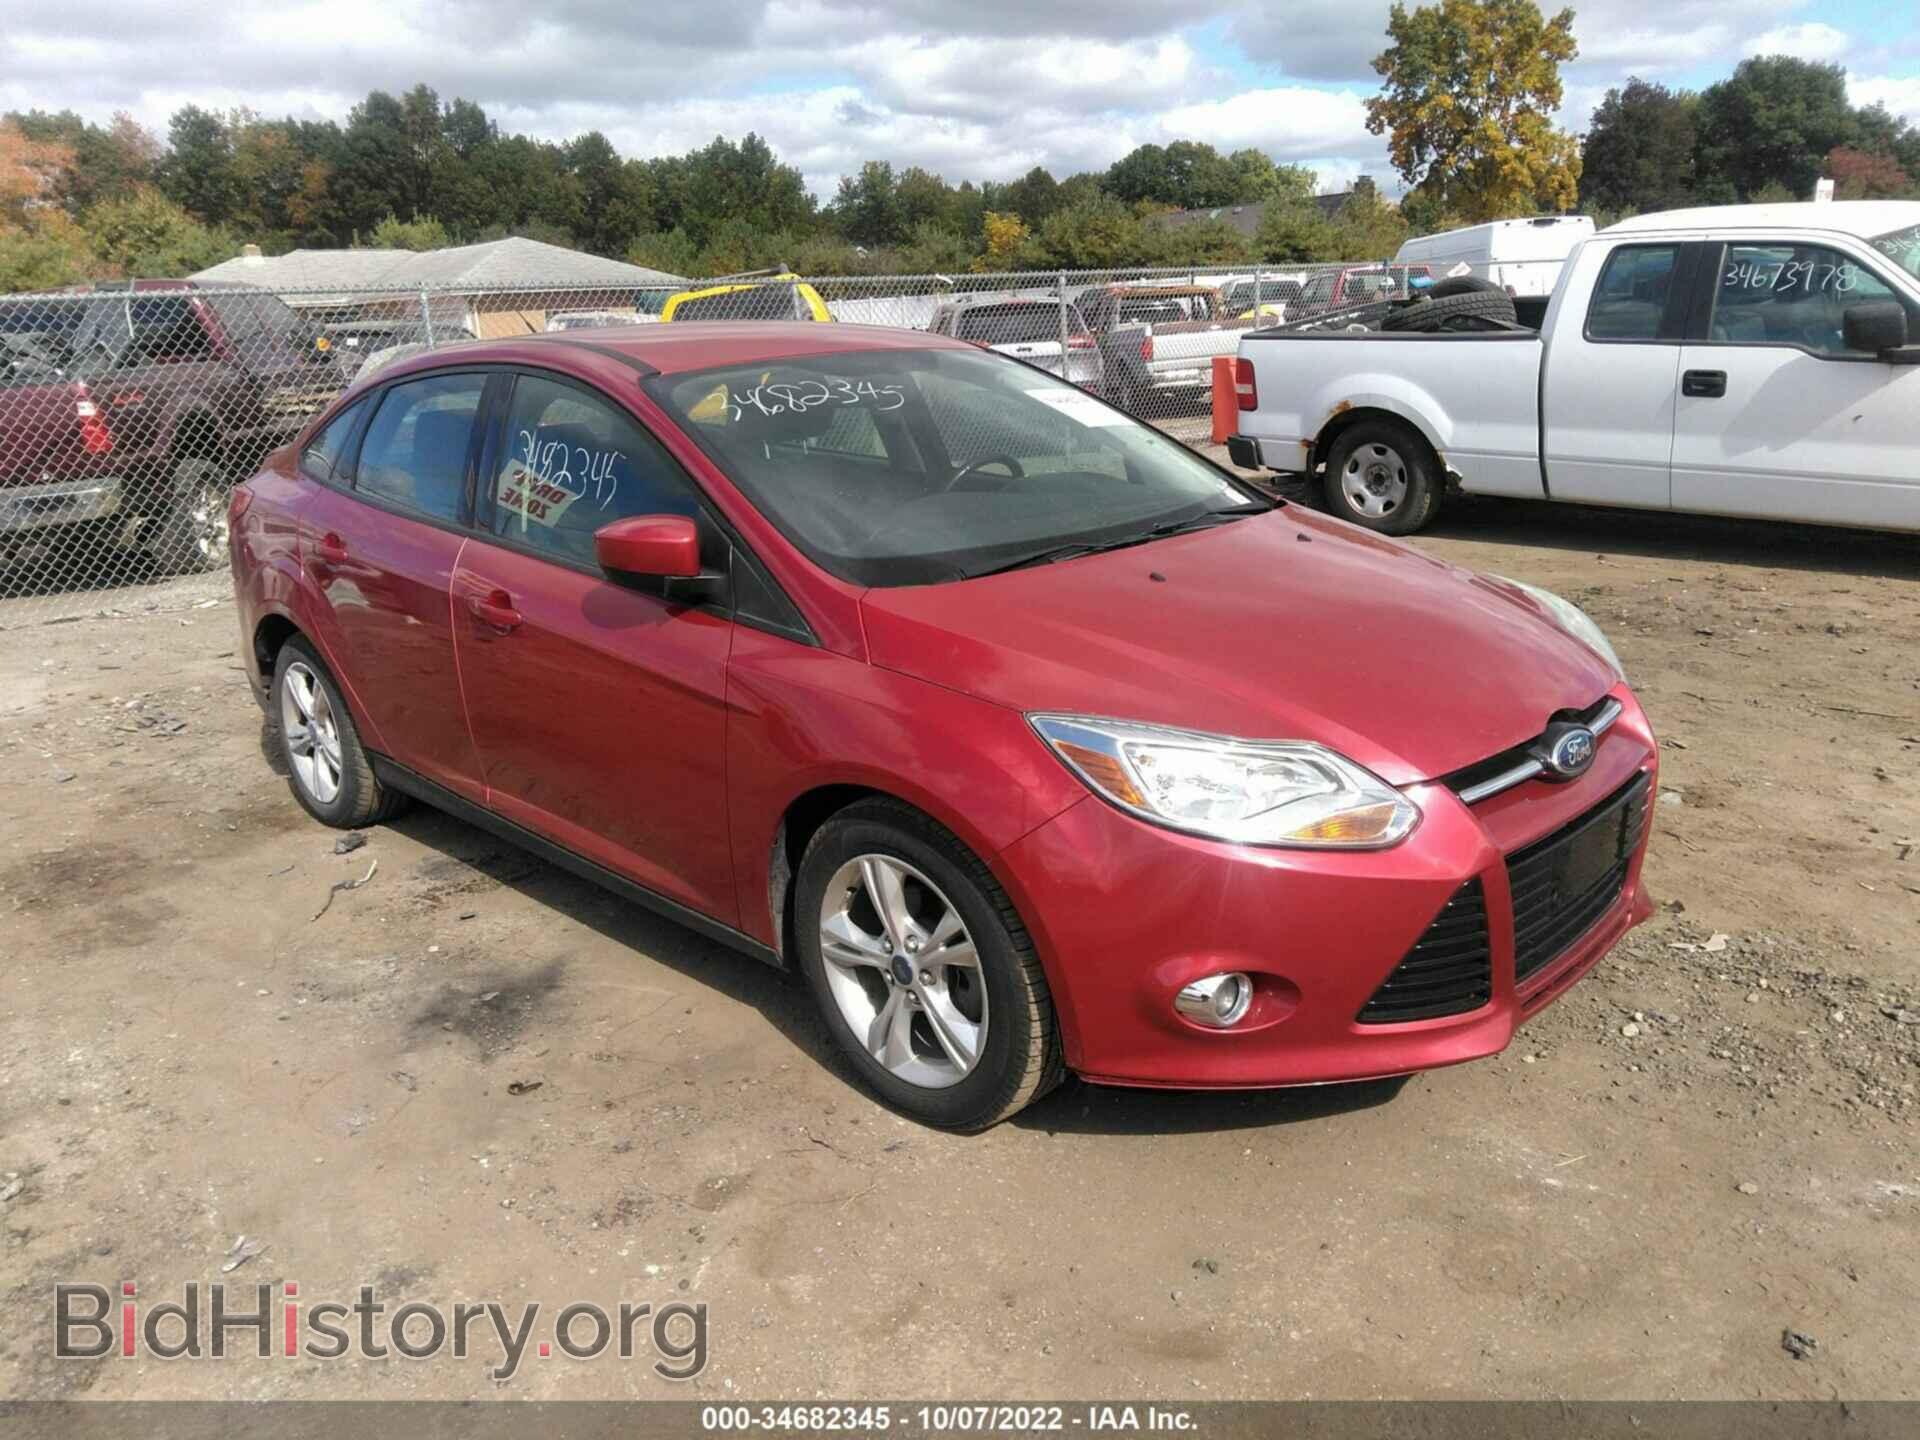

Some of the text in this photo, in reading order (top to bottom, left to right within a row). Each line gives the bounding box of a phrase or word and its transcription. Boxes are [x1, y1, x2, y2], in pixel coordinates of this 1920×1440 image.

[1724, 260, 1858, 291] 34673978
[704, 380, 905, 421] 34682345
[1567, 735, 1592, 765] Ford
